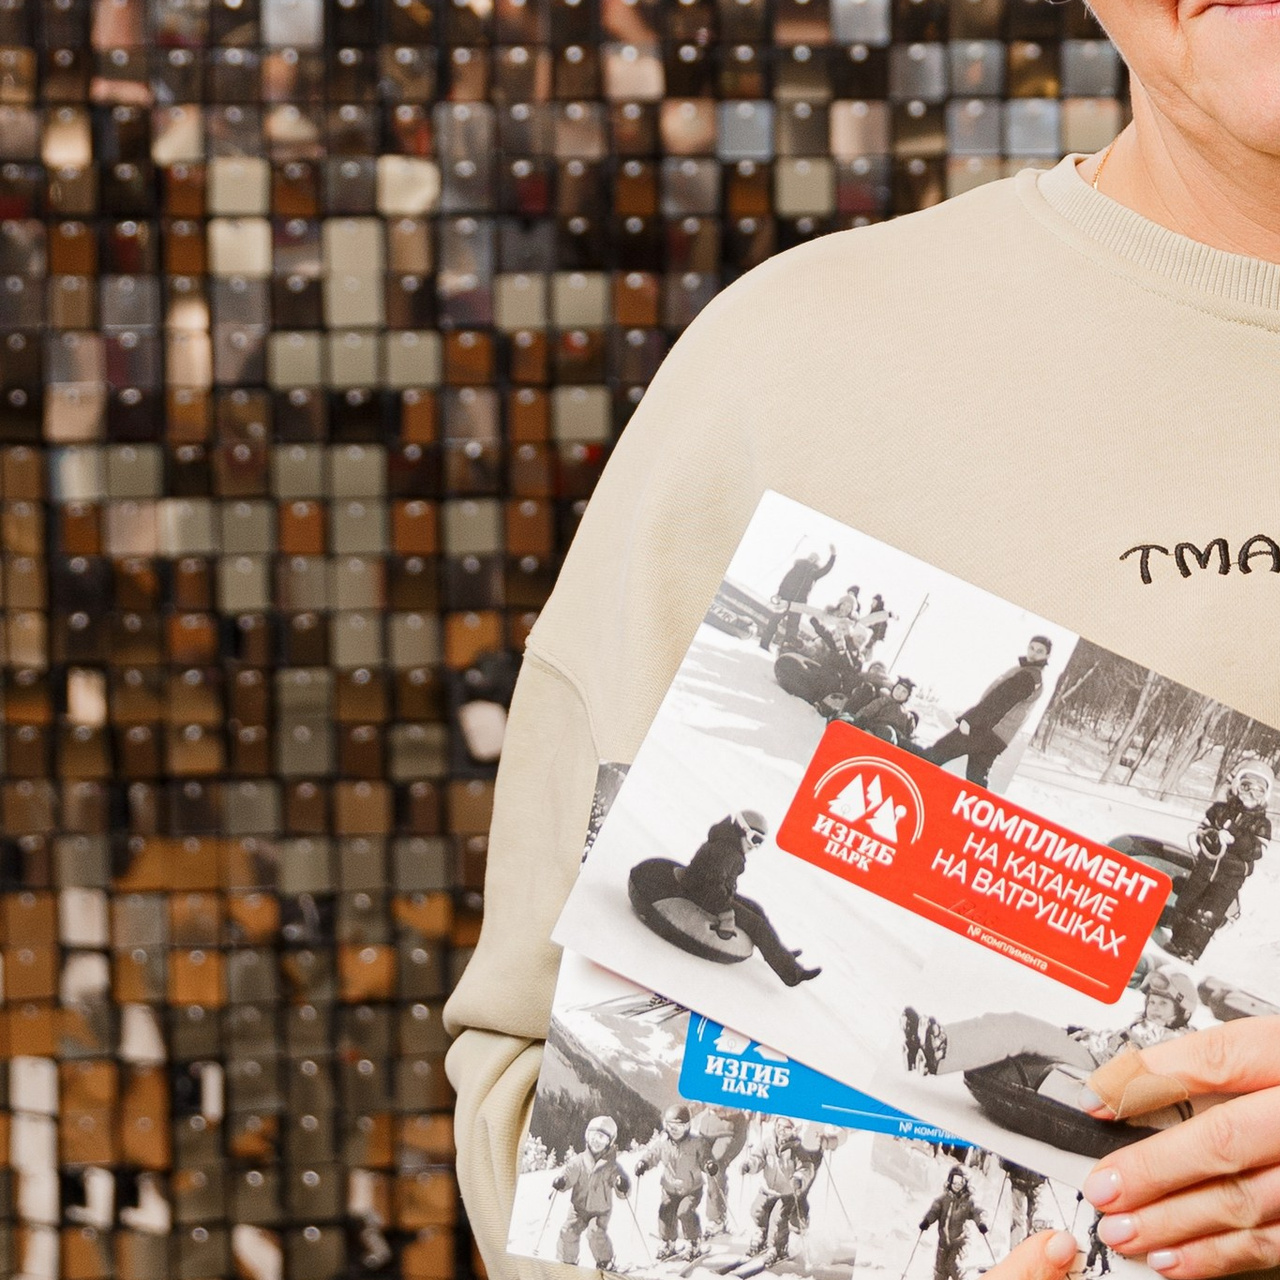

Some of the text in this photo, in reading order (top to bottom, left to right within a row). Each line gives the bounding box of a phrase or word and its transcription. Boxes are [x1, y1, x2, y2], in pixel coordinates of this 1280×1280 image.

[811, 813, 897, 866] ИЗГИБ
[824, 839, 873, 873] ПАРК
[952, 790, 1158, 904] КОМПЛИМЕНТ
[962, 831, 999, 868] НА
[1003, 850, 1119, 923] КАТАНИЕ
[930, 847, 968, 884] НА
[971, 866, 1127, 958] ВАТРУШКАХ
[981, 932, 1049, 971] комплимента
[704, 1054, 791, 1088] ИЗГИБ
[721, 1076, 770, 1099] ПАРК
